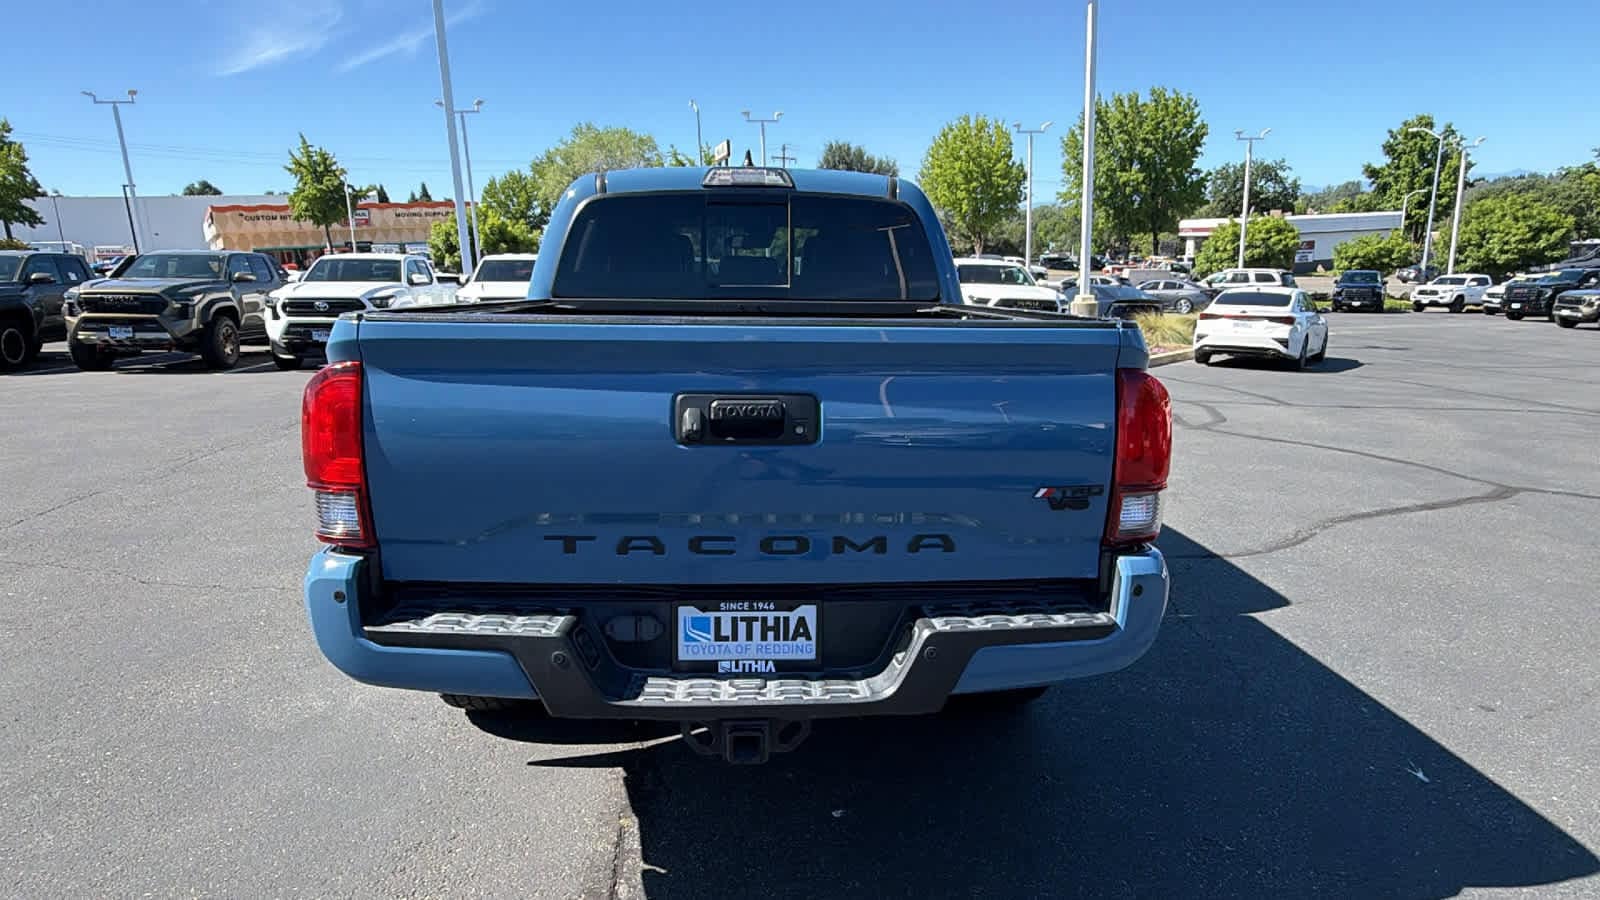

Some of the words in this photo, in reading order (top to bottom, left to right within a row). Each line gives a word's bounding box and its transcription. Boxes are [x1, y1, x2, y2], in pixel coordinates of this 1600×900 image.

[716, 404, 779, 417] TOYOTA
[543, 533, 957, 556] TACOMA
[719, 601, 749, 611] SINCE
[752, 601, 775, 610] 1946
[713, 616, 813, 642] LITHIA
[683, 643, 732, 655] TOYOTA
[735, 643, 752, 655] OF
[755, 643, 813, 655] REDDING
[731, 660, 776, 673] LITHIA
